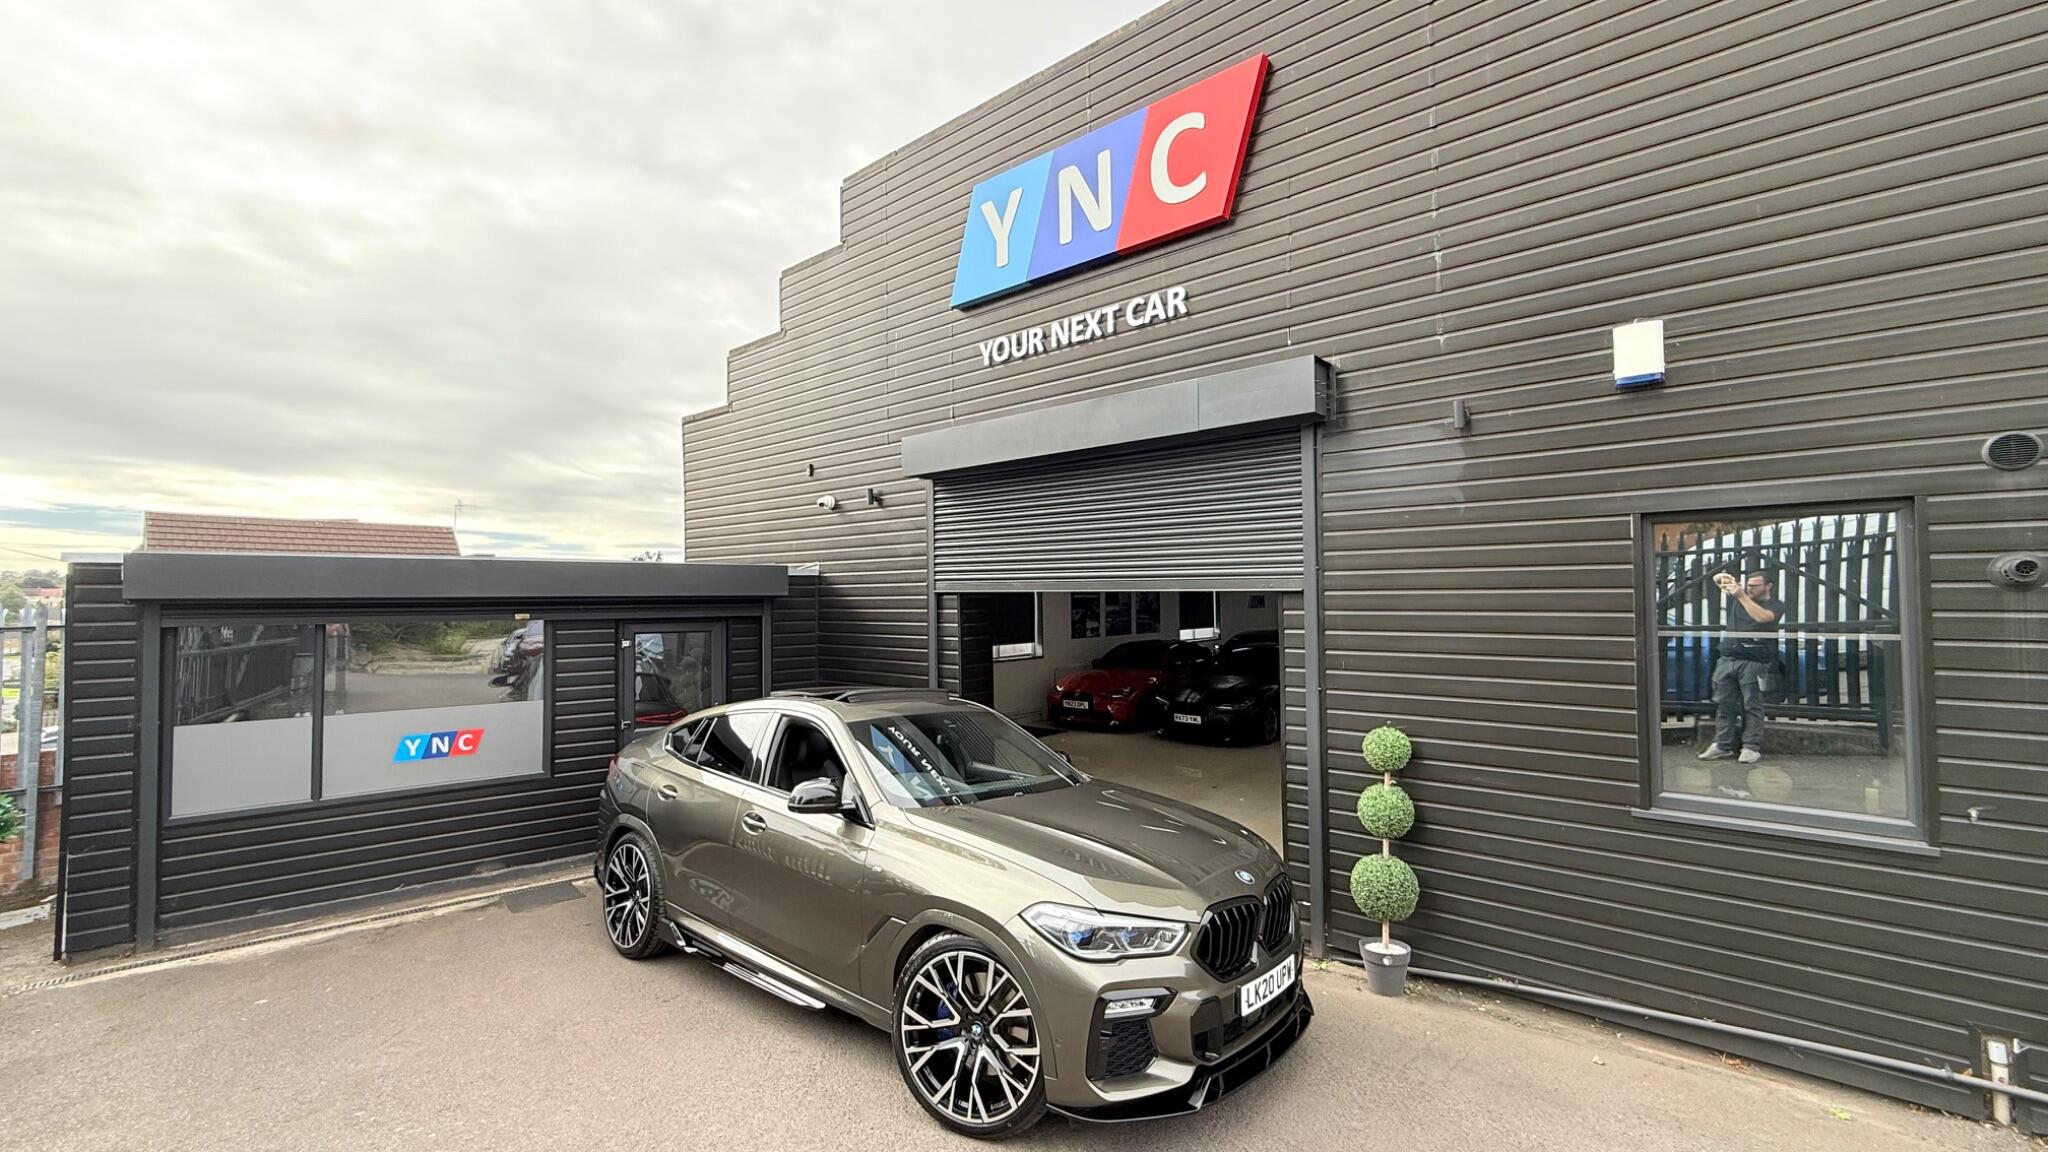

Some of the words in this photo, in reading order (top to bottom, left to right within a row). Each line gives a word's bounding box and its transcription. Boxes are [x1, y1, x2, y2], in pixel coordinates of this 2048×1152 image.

[980, 112, 1207, 268] YNC
[978, 327, 1044, 366] YOUR
[1050, 305, 1118, 348] NEXT
[1125, 286, 1188, 327] CAR
[404, 734, 474, 757] YNC
[1246, 974, 1275, 1009] LK20
[1276, 960, 1292, 990] UPW
